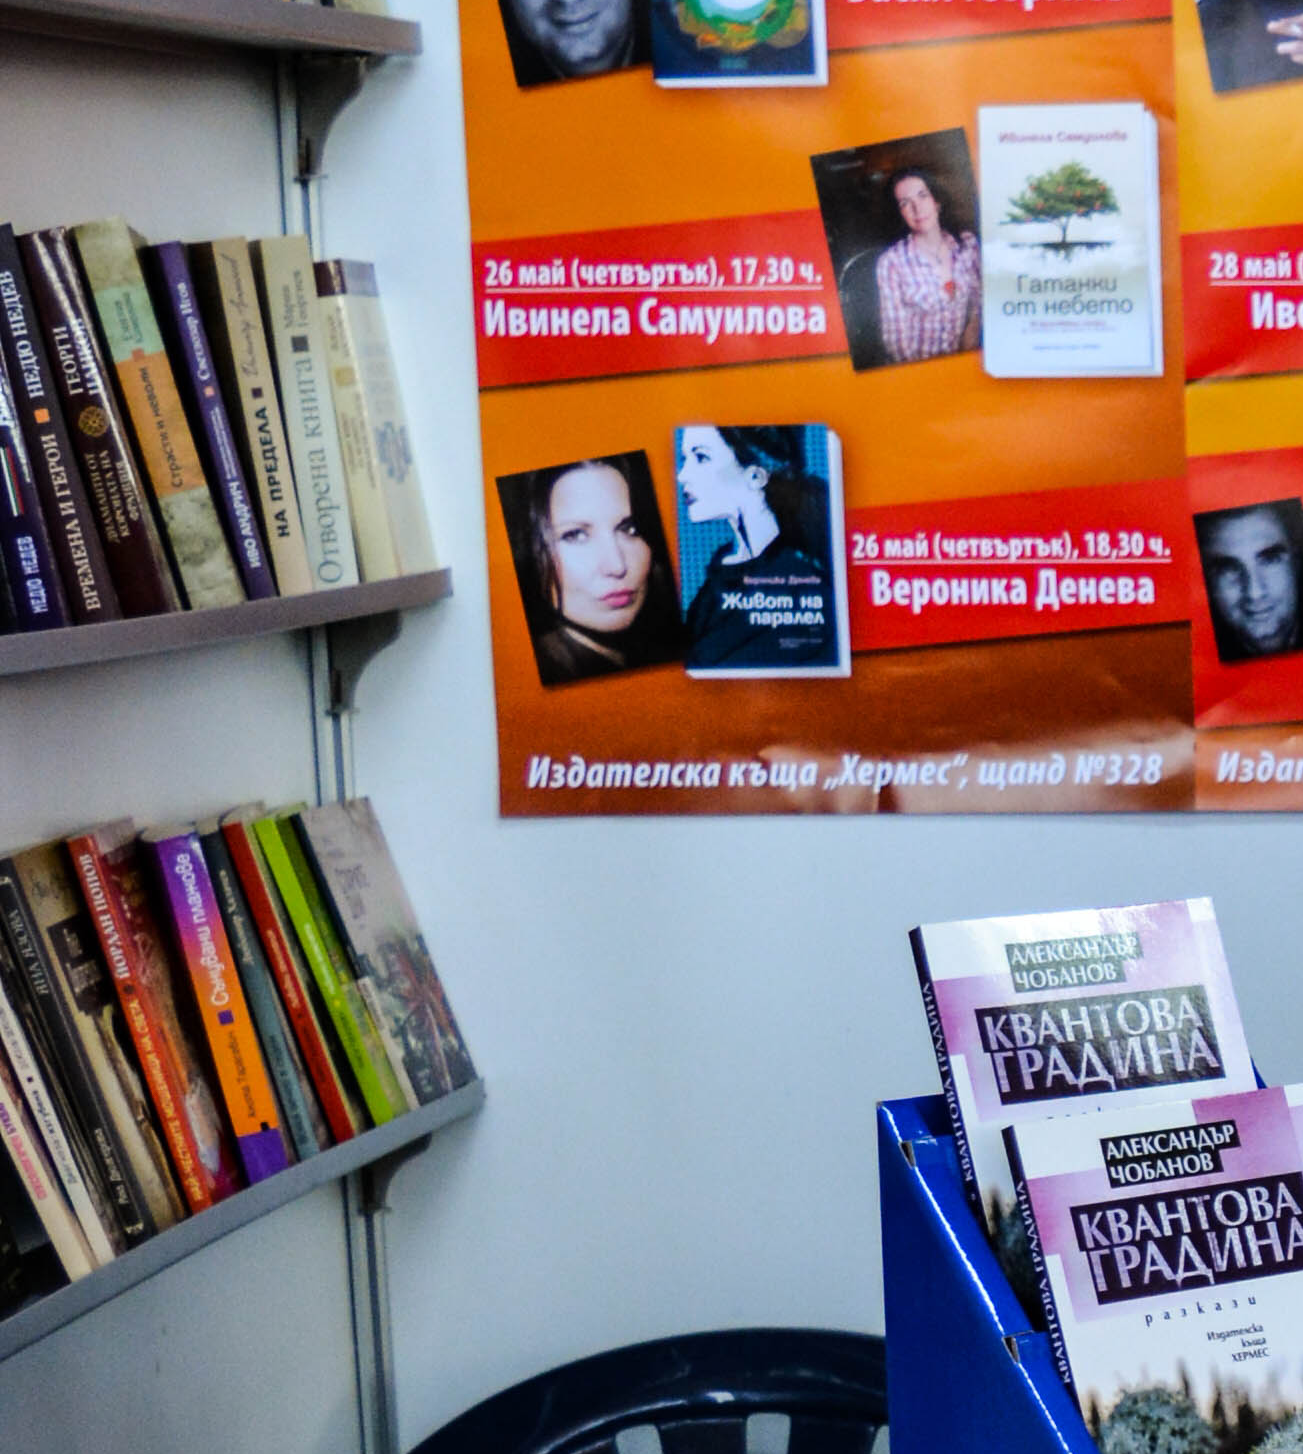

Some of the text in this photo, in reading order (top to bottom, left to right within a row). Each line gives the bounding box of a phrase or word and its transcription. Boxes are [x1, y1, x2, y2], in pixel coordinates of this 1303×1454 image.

[0, 270, 30, 337] НЕДЕВ
[483, 299, 827, 343] Ивинела Самуилова
[18, 340, 45, 399] НЕДЮ
[53, 325, 84, 395] ГЕОРГИ
[39, 433, 73, 498] ГЕРОИ
[253, 407, 291, 538] НА ПРЕДЕЛА
[291, 356, 344, 583] Отворена книга
[228, 481, 257, 536] АНДРИЧ
[66, 518, 101, 610] ВРЕМЕНА
[243, 538, 262, 568] ИВО
[871, 570, 1155, 614] Вероника Денева
[173, 853, 230, 1005] Сънувани плажове
[983, 996, 1204, 1053] КВАНТОВА
[997, 1031, 1221, 1094] ГРАДИНА
[1106, 1123, 1237, 1162] АЛЕКСАНДЪР
[1109, 1152, 1215, 1185] ЧОБАНОВ
[1079, 1180, 1303, 1251] КВАНТОВА
[1016, 1180, 1072, 1384] КВАНТОВА ГРАДИНА
[1206, 1323, 1265, 1344] Издателска
[1231, 1346, 1270, 1364] ХЕРМЕС
